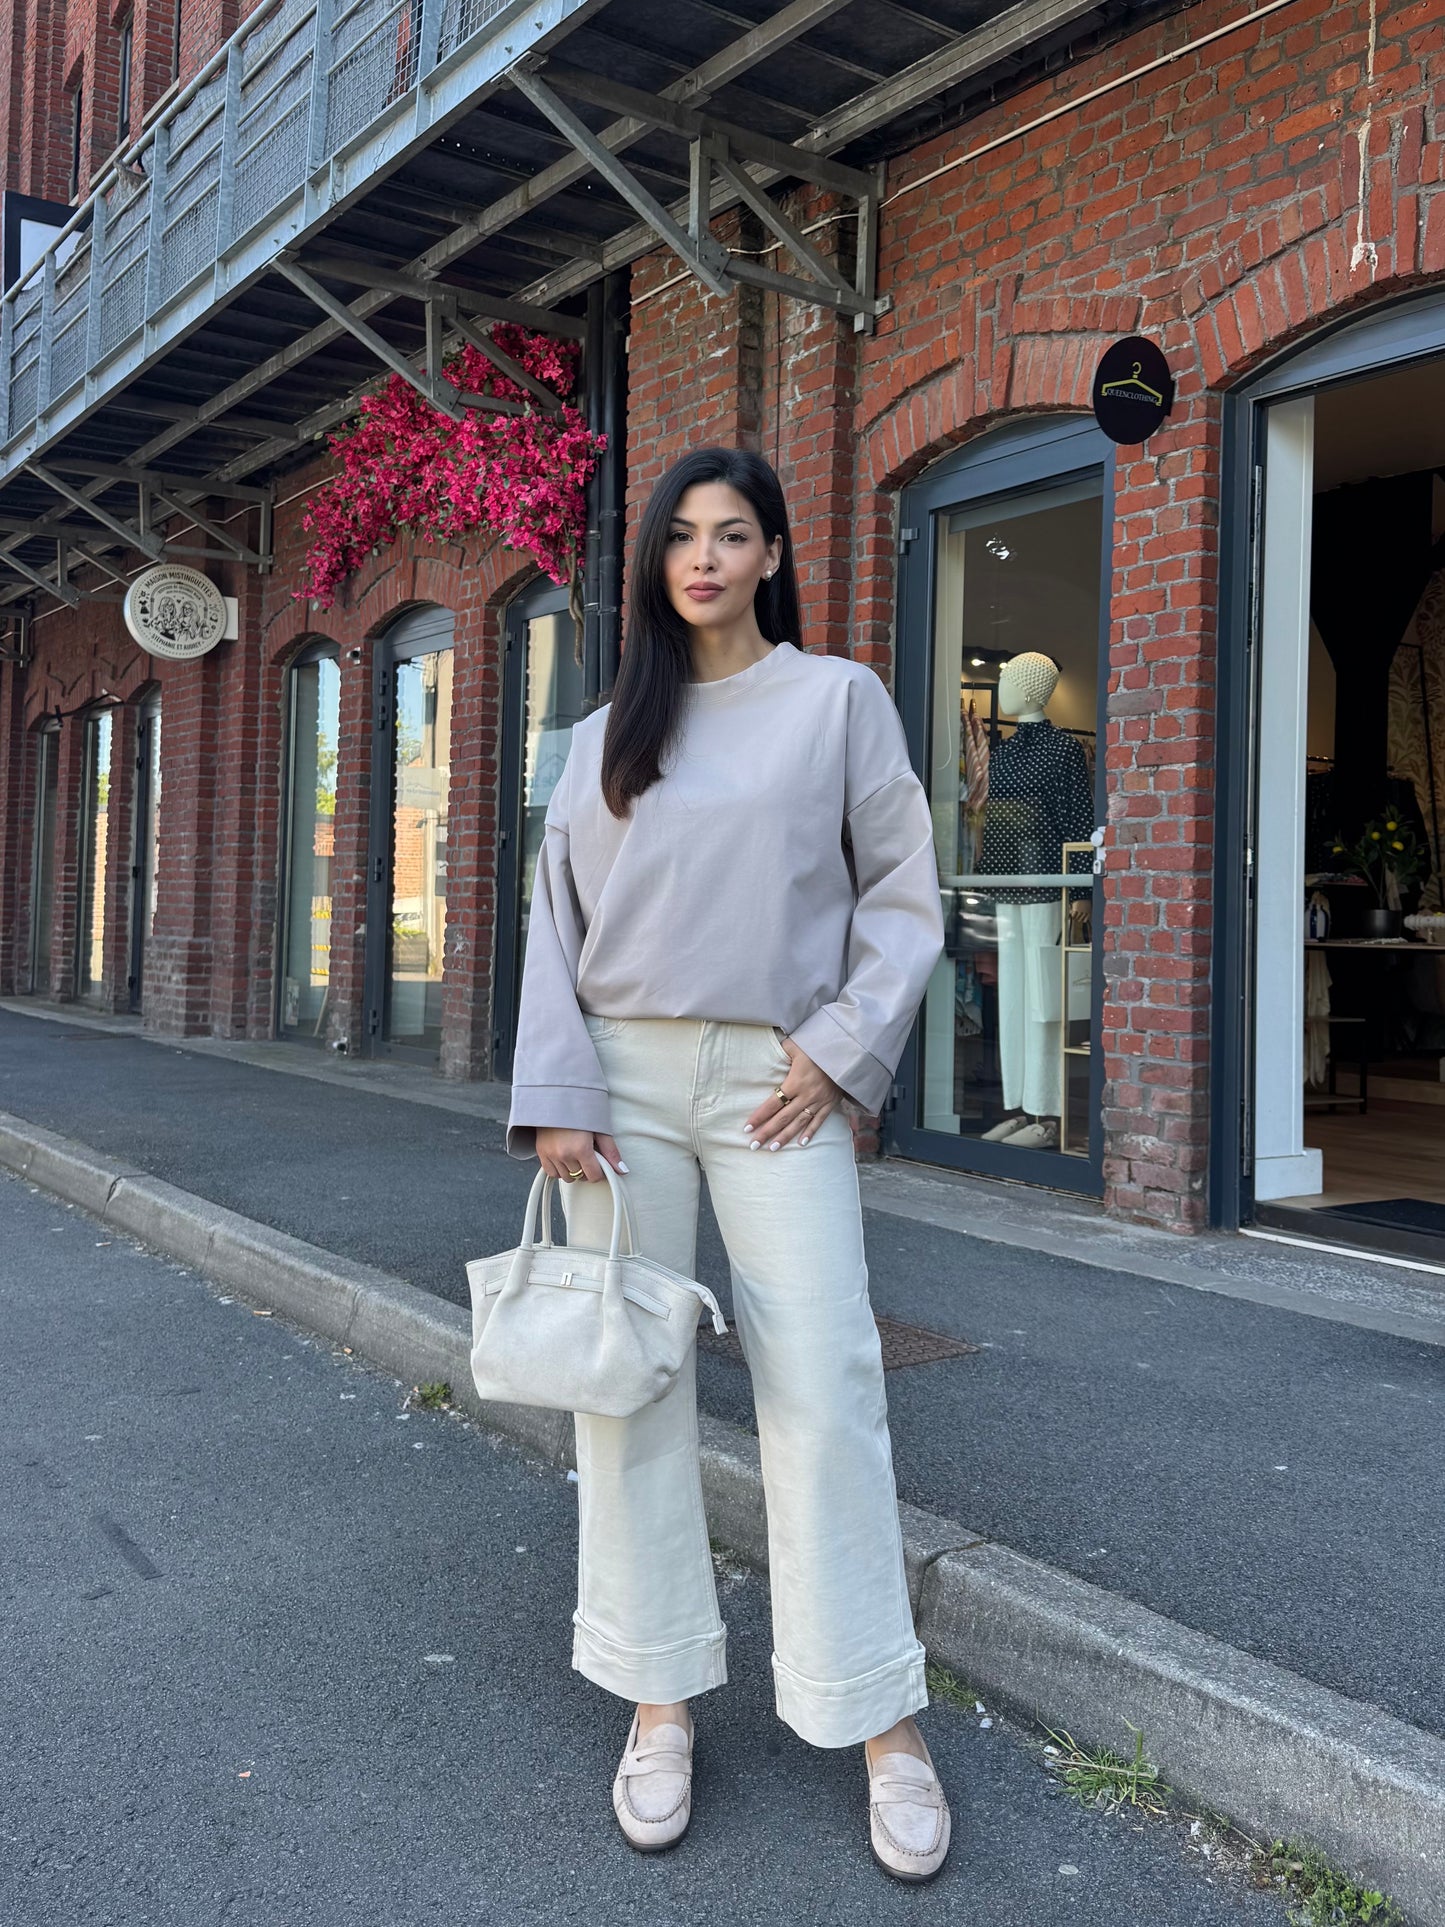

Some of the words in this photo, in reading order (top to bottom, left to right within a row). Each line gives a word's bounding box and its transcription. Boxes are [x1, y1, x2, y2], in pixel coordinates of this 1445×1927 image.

[1106, 388, 1157, 403] QUEENCLOTHING
[145, 572, 168, 588] MAISON
[168, 572, 213, 598] MISTINGUETTES
[183, 641, 202, 650] AUDREY
